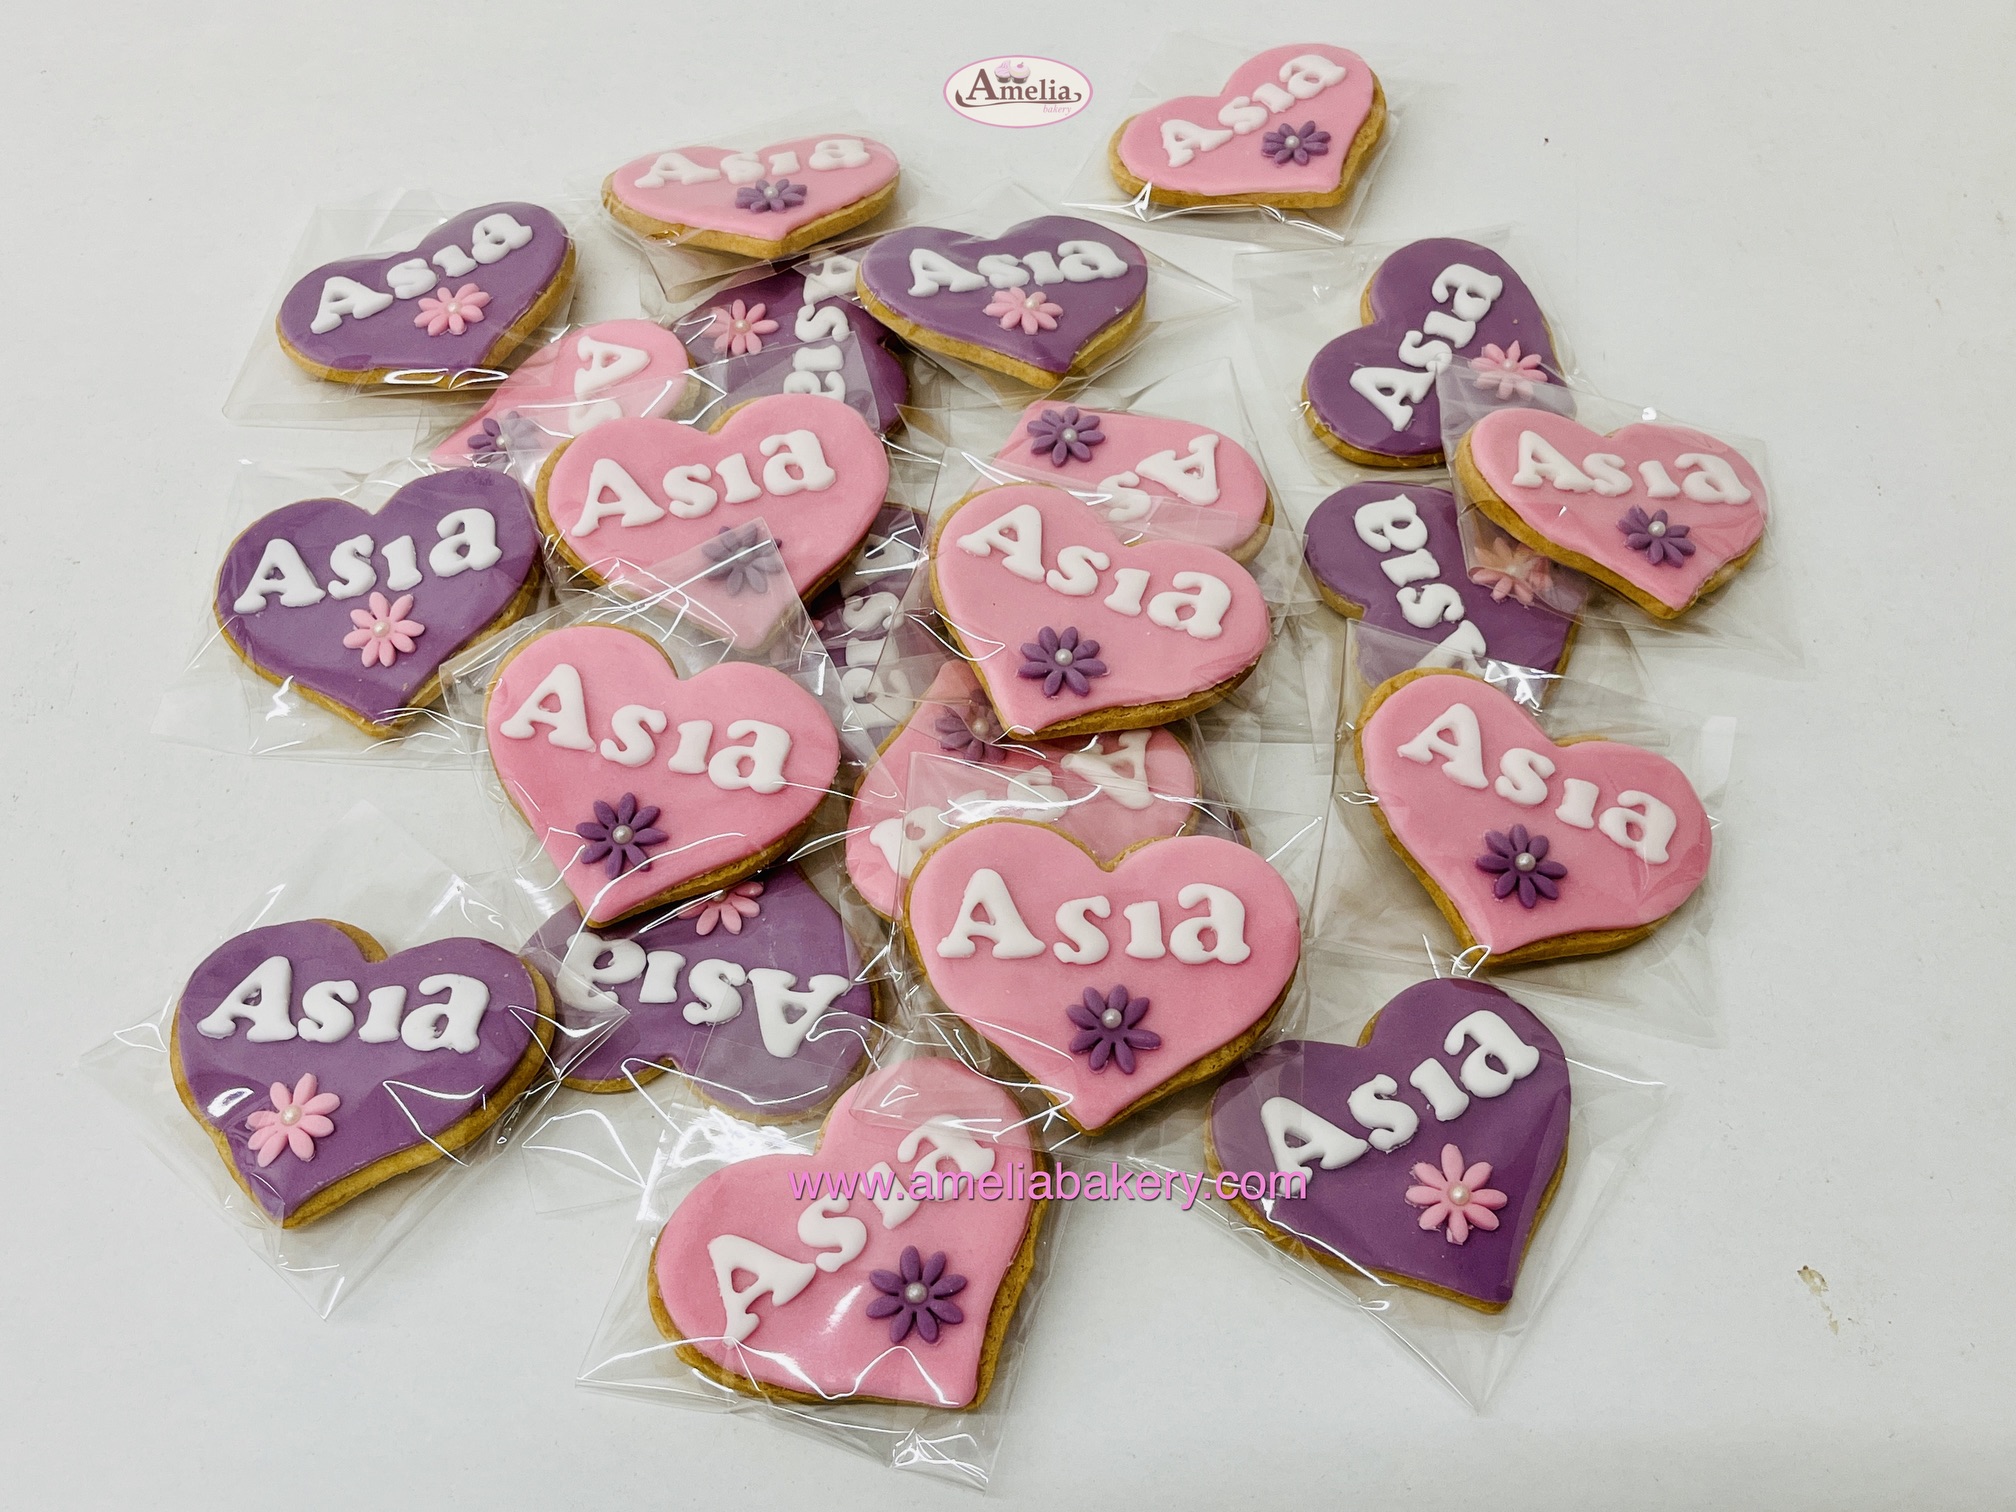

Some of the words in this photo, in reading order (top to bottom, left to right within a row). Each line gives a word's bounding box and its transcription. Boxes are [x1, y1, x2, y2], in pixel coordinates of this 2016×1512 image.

[634, 139, 871, 189] Asia
[1160, 54, 1349, 168] Asia
[311, 213, 533, 334] Asia
[908, 240, 1129, 297] Asia
[567, 335, 650, 435] As
[1350, 263, 1504, 432] Asia
[572, 429, 838, 537] Asia
[1097, 433, 1221, 522] As
[1512, 430, 1751, 505] Asia
[233, 507, 503, 614] Asia
[957, 504, 1232, 639] Asia
[500, 663, 792, 795] Asia
[1398, 703, 1677, 865] Asia
[937, 868, 1251, 965] Asia
[196, 955, 492, 1054] Asia
[557, 932, 852, 1058] Asia
[1260, 1010, 1540, 1195] Asia
[698, 1115, 996, 1347] Asia
